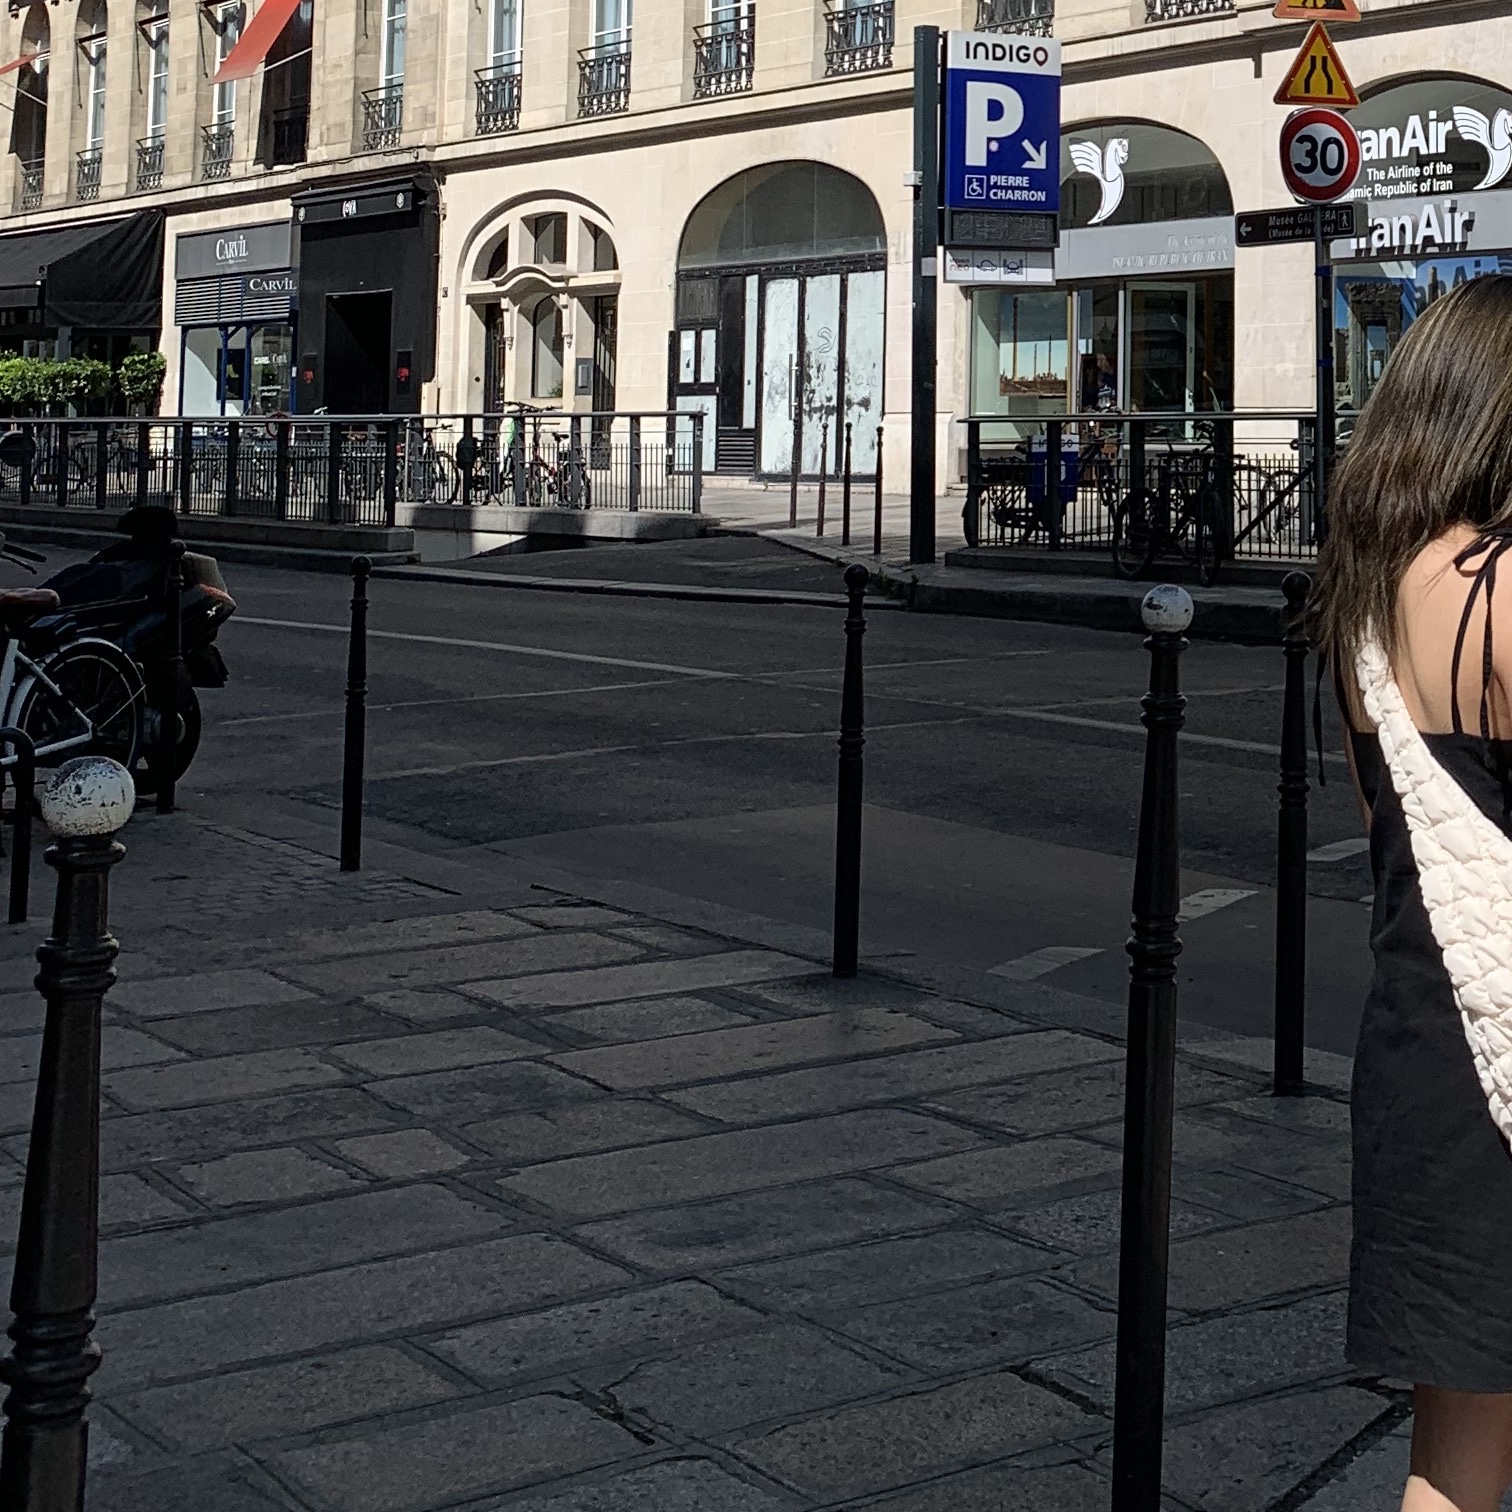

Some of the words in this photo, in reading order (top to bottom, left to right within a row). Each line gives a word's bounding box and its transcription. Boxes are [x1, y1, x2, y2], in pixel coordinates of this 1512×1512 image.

[966, 41, 1049, 67] INDIGO
[965, 80, 1025, 167] P
[1293, 134, 1346, 177] 30
[989, 174, 1030, 187] PIERRE
[1366, 168, 1386, 182] The
[1387, 164, 1421, 180] Airline
[1422, 161, 1435, 176] of
[1435, 160, 1454, 175] the
[989, 188, 1047, 202] CHARRON
[1374, 180, 1419, 199] Republic
[1420, 178, 1432, 193] of
[1432, 177, 1454, 192] Iran
[1268, 215, 1295, 227] Musée
